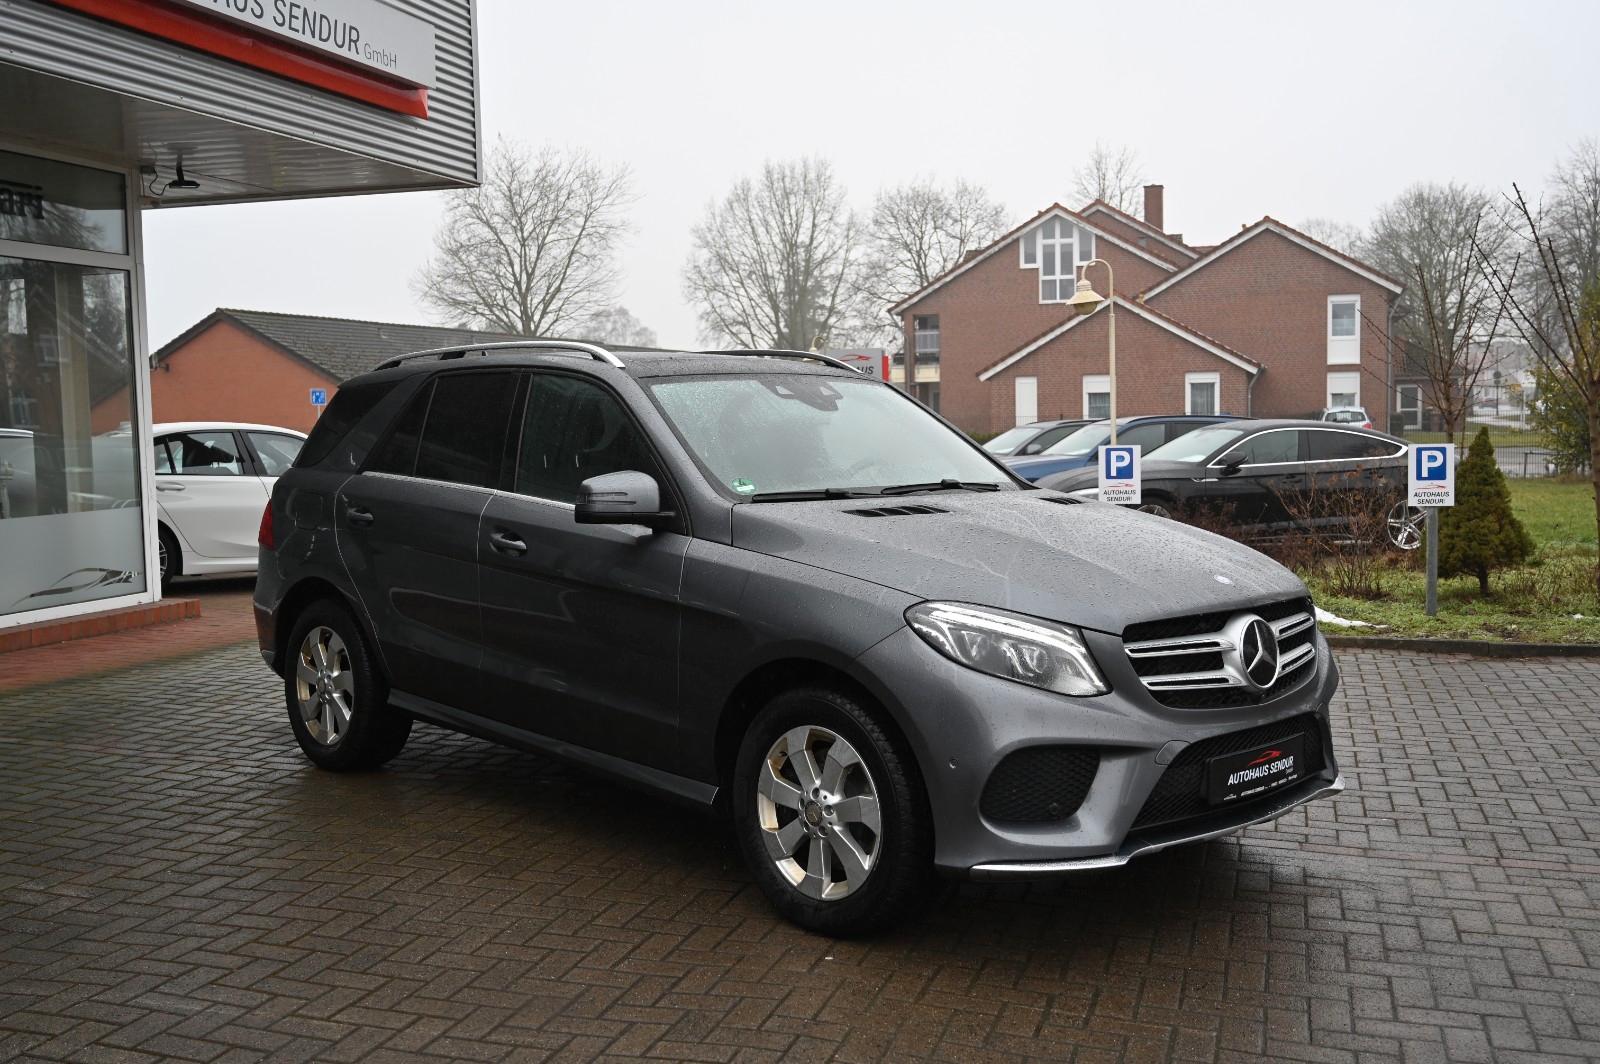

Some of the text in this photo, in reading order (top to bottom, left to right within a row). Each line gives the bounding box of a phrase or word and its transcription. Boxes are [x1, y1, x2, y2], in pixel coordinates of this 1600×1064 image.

[273, 0, 360, 55] SENDUR
[364, 43, 398, 69] GmbH
[1110, 450, 1131, 477] P
[1421, 450, 1444, 478] P
[1227, 764, 1269, 786] AUTOHAUS
[1269, 755, 1294, 774] SENDUR
